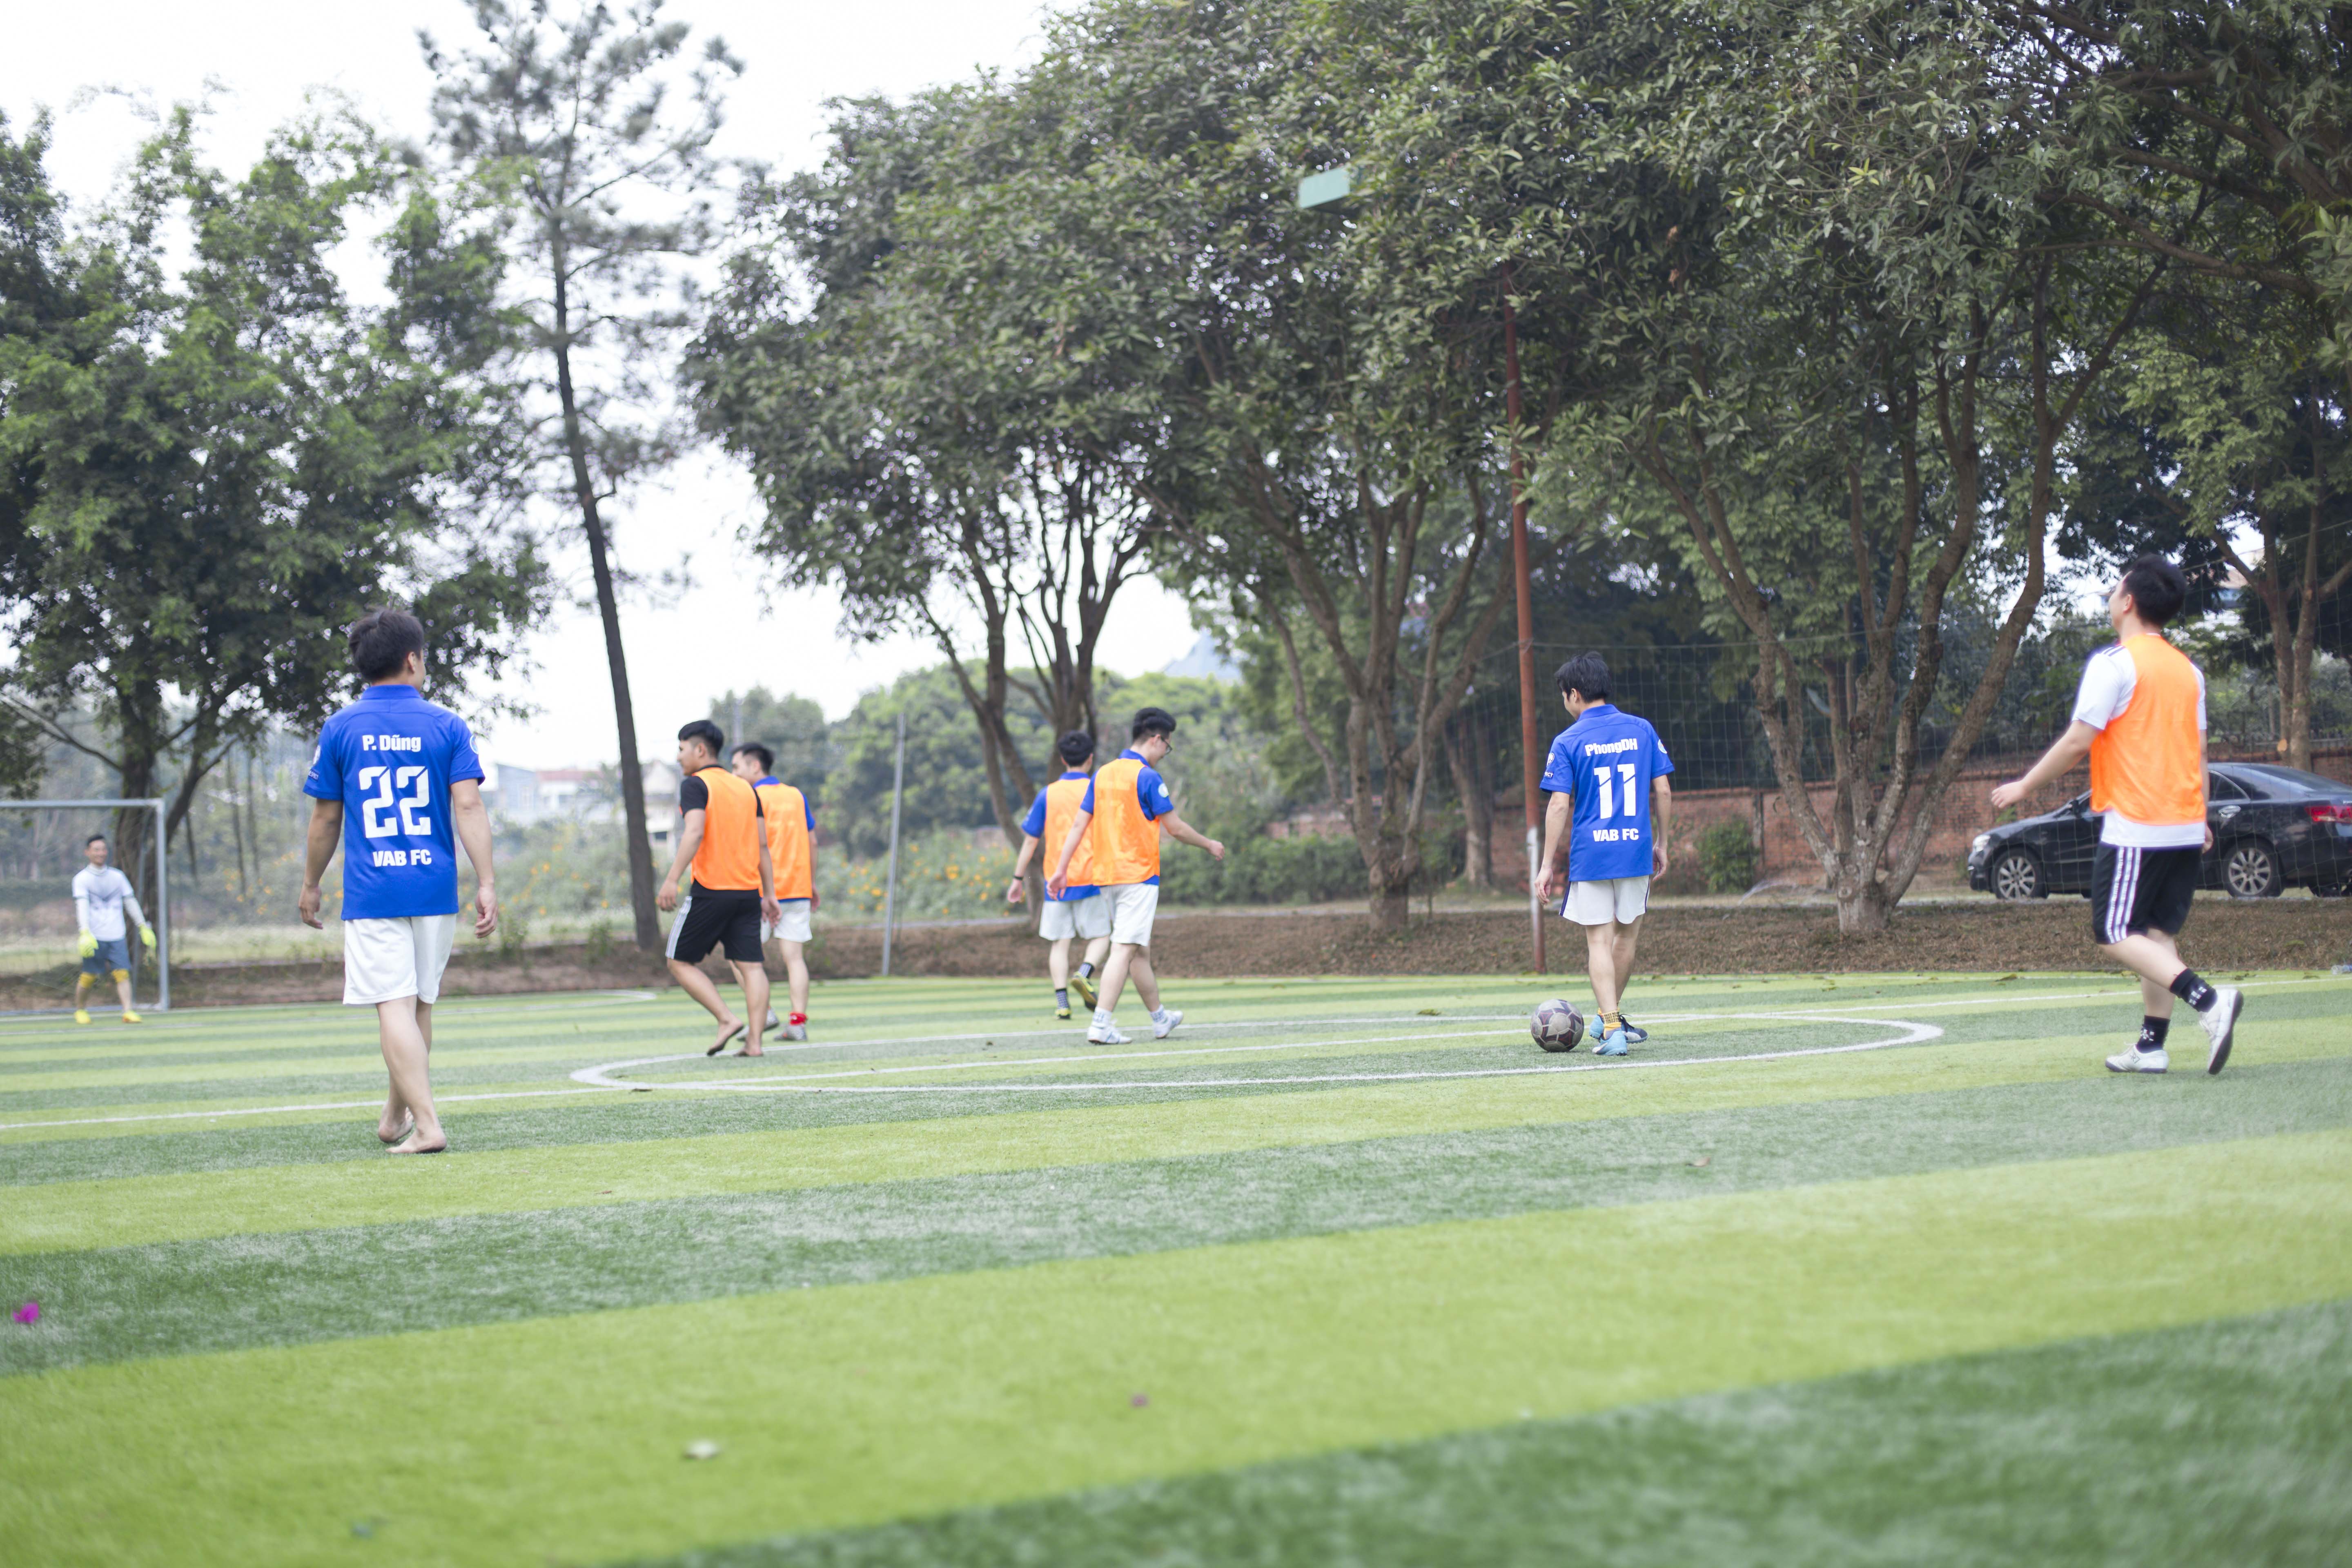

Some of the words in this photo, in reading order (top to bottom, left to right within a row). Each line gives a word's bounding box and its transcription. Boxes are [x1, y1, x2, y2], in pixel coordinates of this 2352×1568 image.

[362, 735, 377, 751] P.
[379, 735, 421, 752] Dũng
[1584, 738, 1638, 757] PhongDH
[1594, 763, 1636, 819] 11
[359, 766, 431, 838] 22
[1593, 829, 1619, 842] VAB
[1622, 828, 1639, 840] FC
[372, 851, 407, 867] VAB
[410, 849, 432, 865] FC
